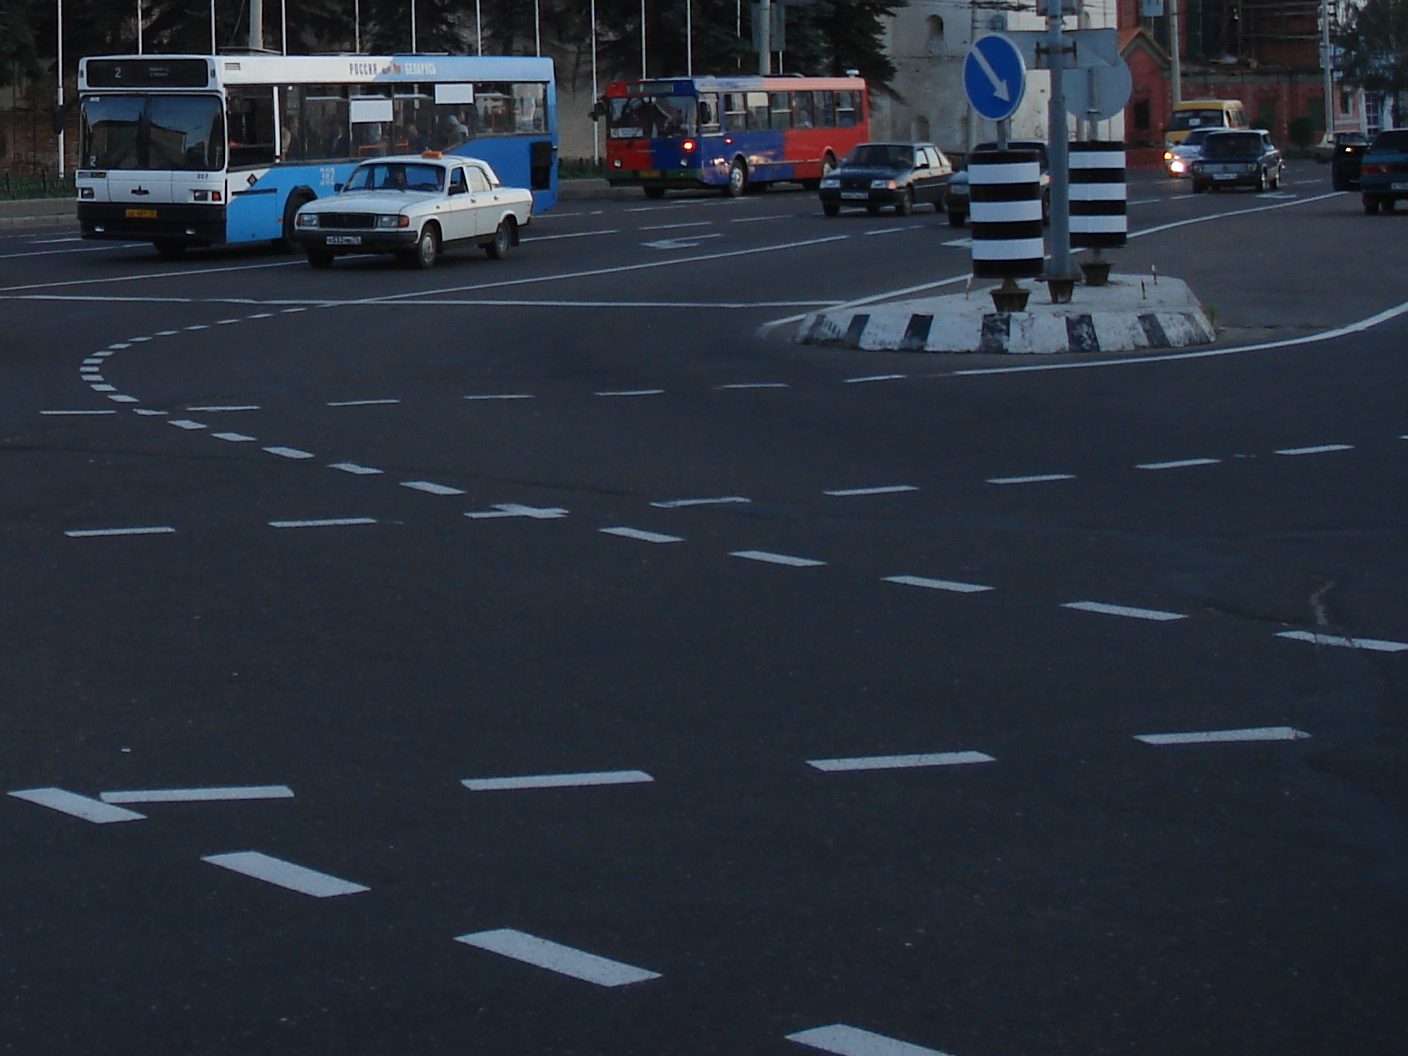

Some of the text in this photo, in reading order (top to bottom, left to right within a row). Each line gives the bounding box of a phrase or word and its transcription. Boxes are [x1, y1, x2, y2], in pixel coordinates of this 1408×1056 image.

[114, 67, 122, 78] 2
[349, 63, 377, 75] РОССИЯ
[89, 155, 97, 167] 2
